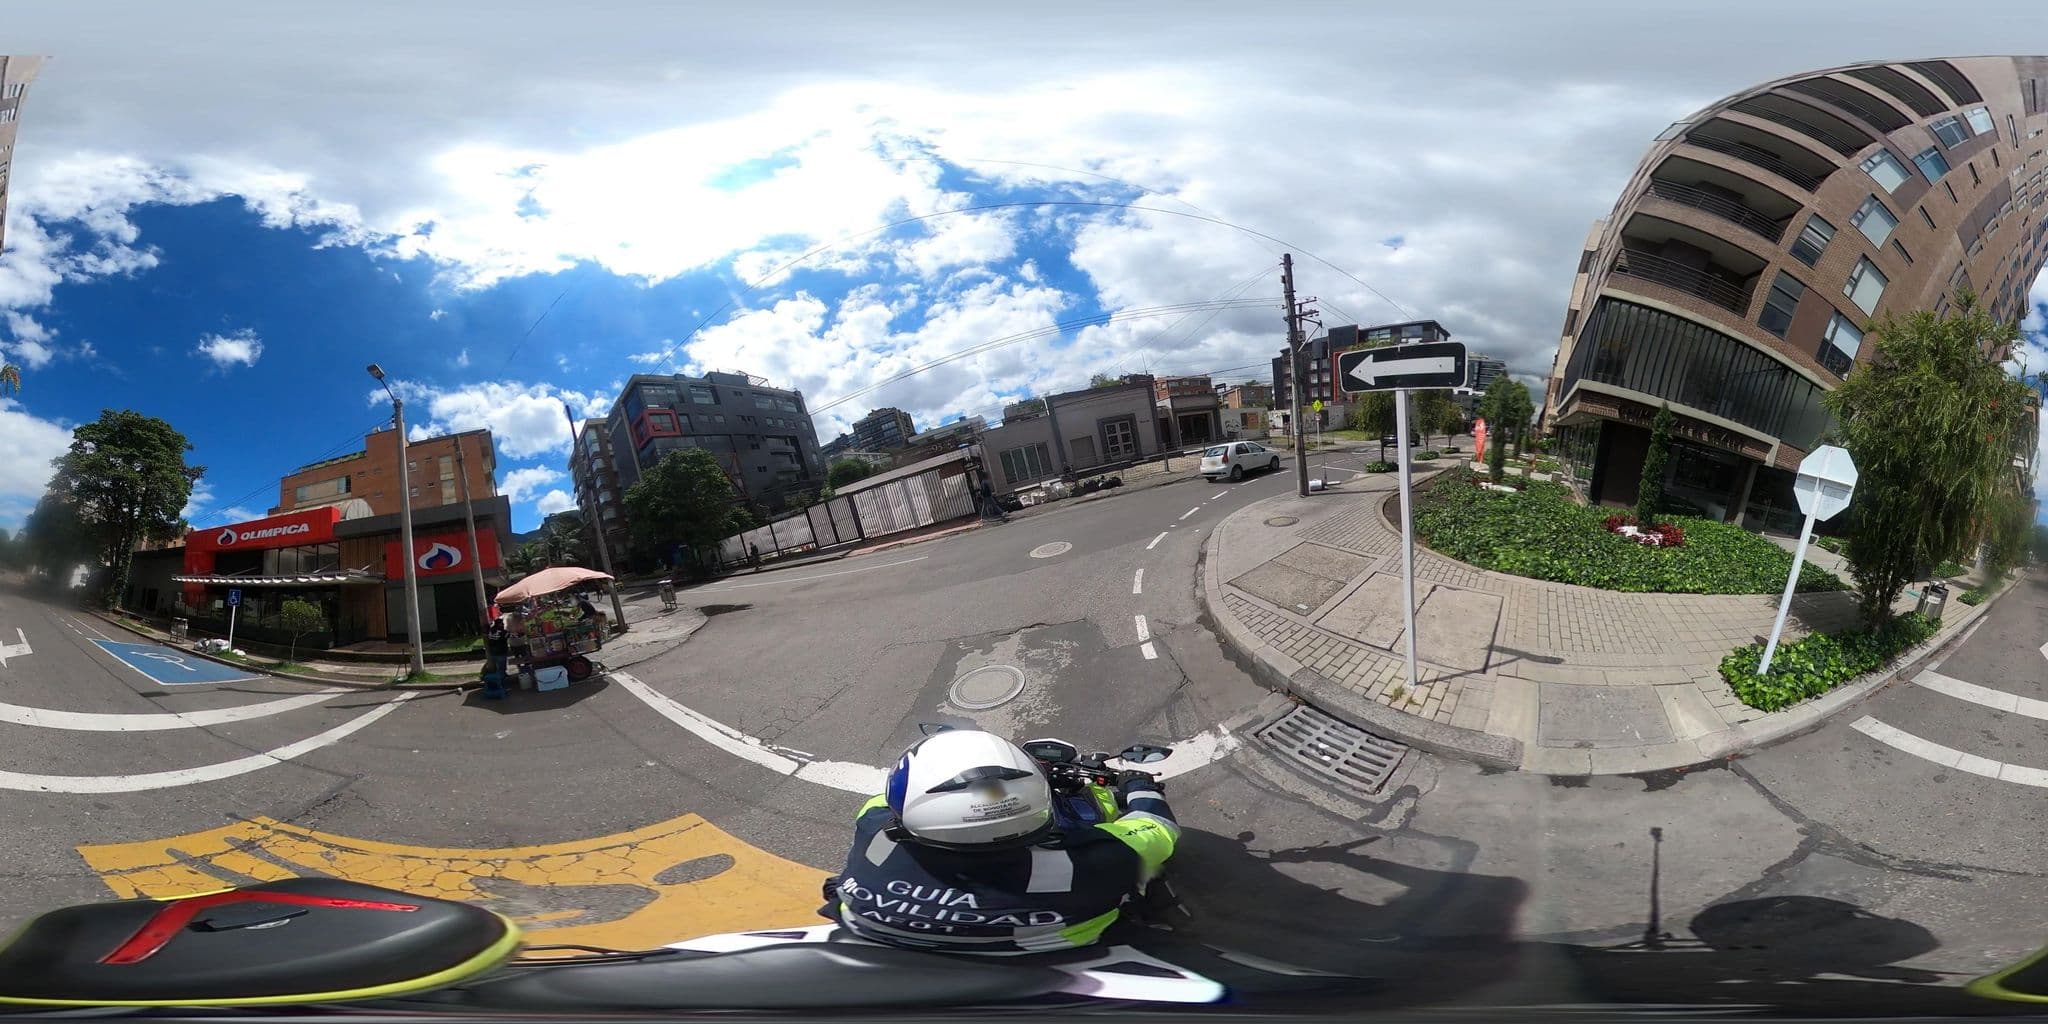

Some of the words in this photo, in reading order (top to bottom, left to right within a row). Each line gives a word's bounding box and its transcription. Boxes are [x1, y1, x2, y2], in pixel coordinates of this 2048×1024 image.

[240, 523, 309, 540] OLIMPICA
[842, 877, 1064, 926] MOVILIDAD
[887, 880, 980, 909] GUÍA
